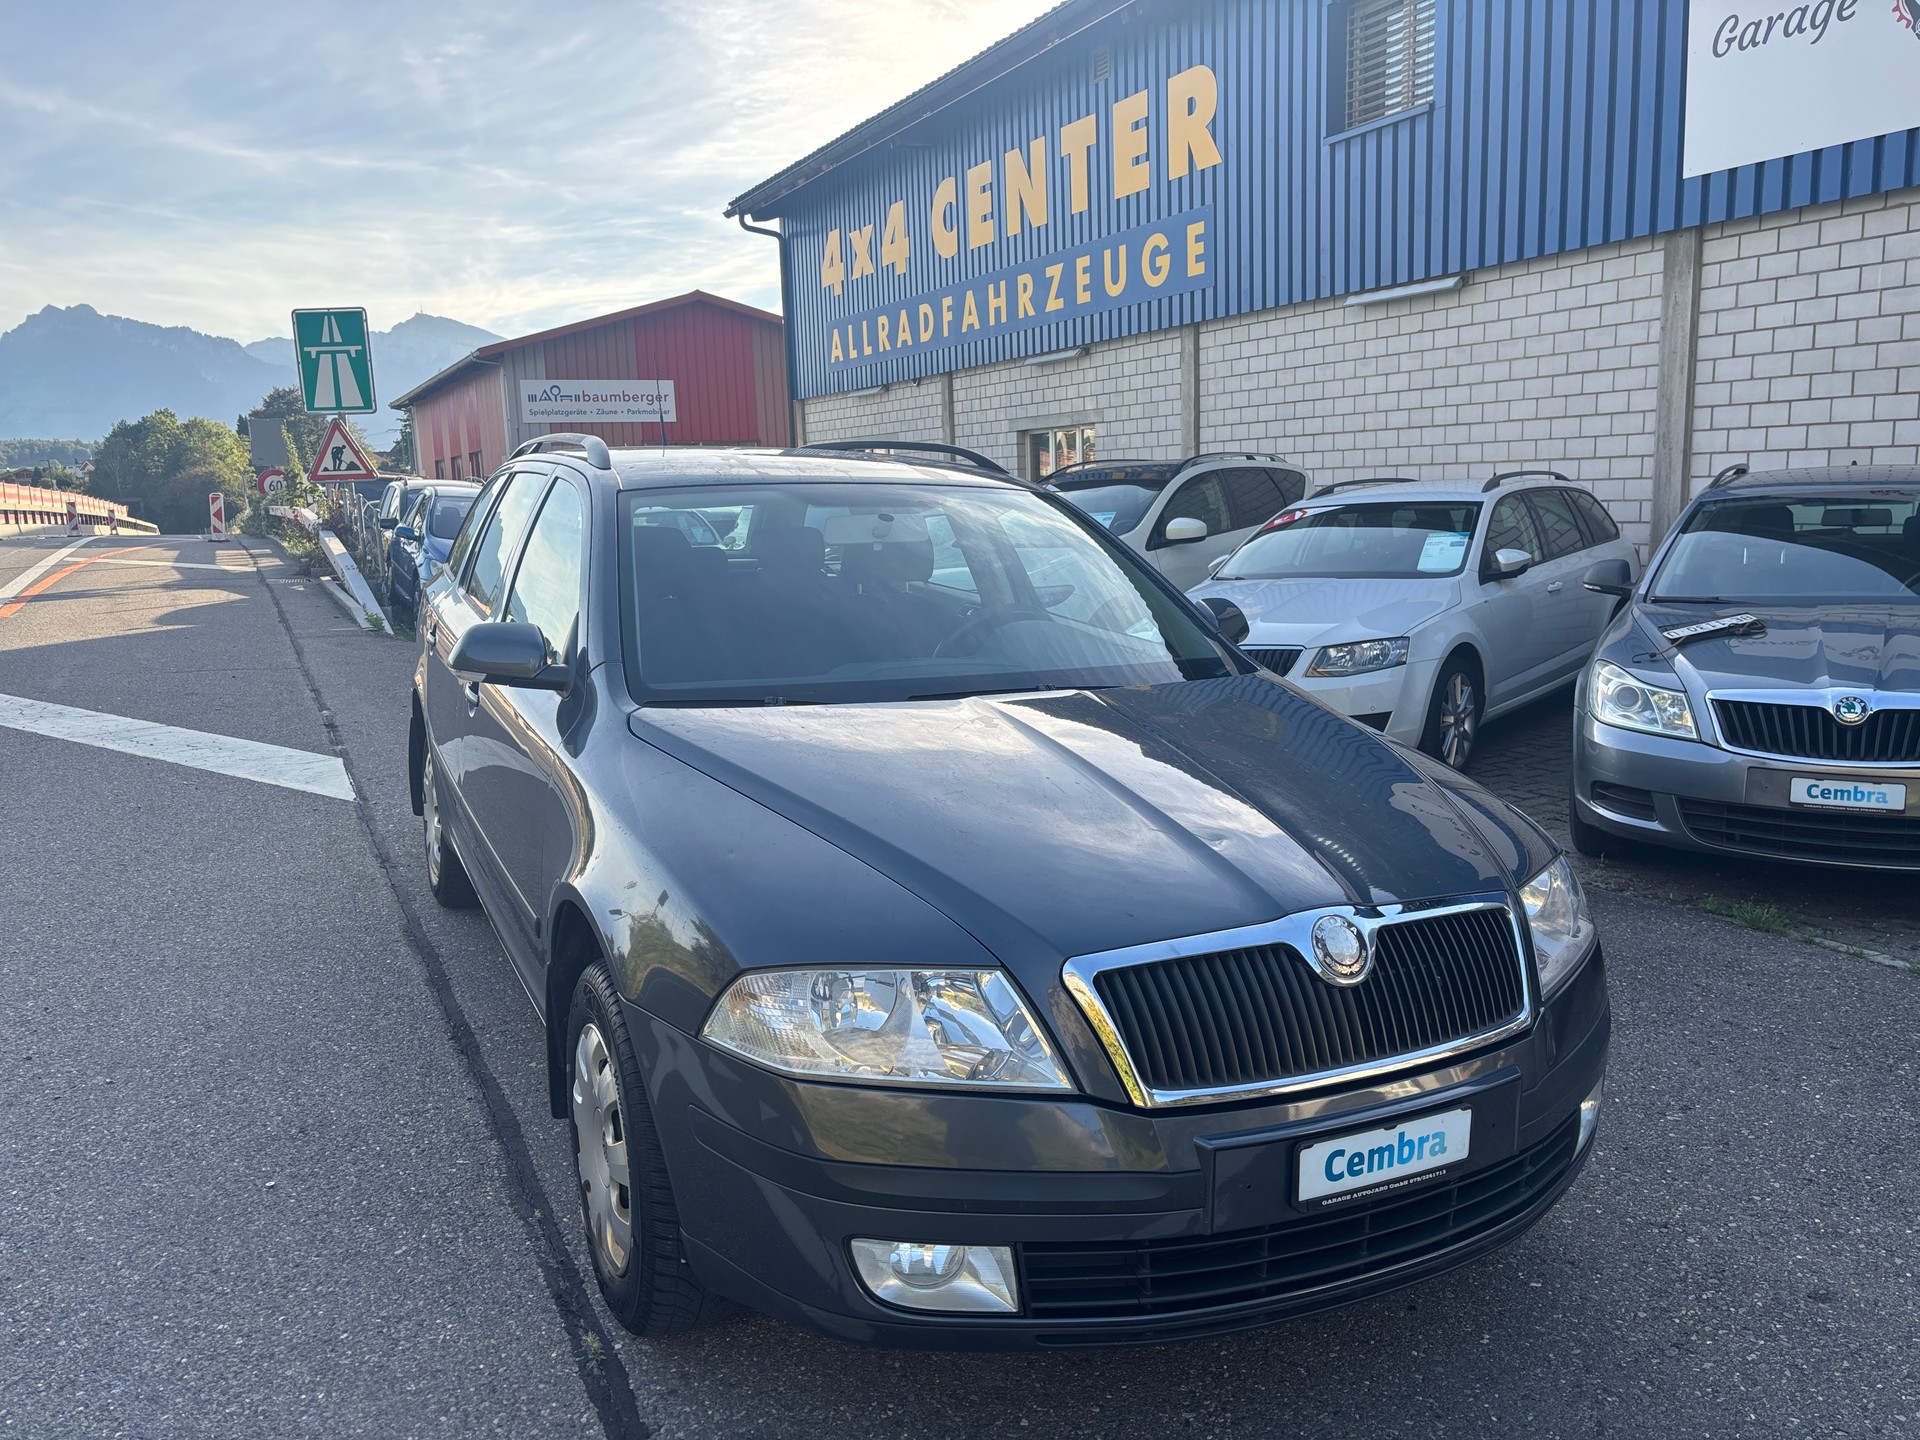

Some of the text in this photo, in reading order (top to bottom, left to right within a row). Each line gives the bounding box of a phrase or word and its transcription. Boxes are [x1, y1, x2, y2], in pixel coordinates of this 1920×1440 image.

[1712, 0, 1858, 58] Garage
[821, 65, 1223, 297] 4x4 CENTER
[830, 221, 1205, 364] ALLRADFAHRZEUGE
[582, 390, 669, 406] baumberger
[528, 408, 587, 417] Spielplatzgeräte
[626, 408, 671, 416] Parkmobiiar
[269, 480, 283, 491] 60
[1806, 783, 1889, 804] Cembra
[1324, 1131, 1448, 1183] Cembra
[1321, 1194, 1352, 1206] GARAGE
